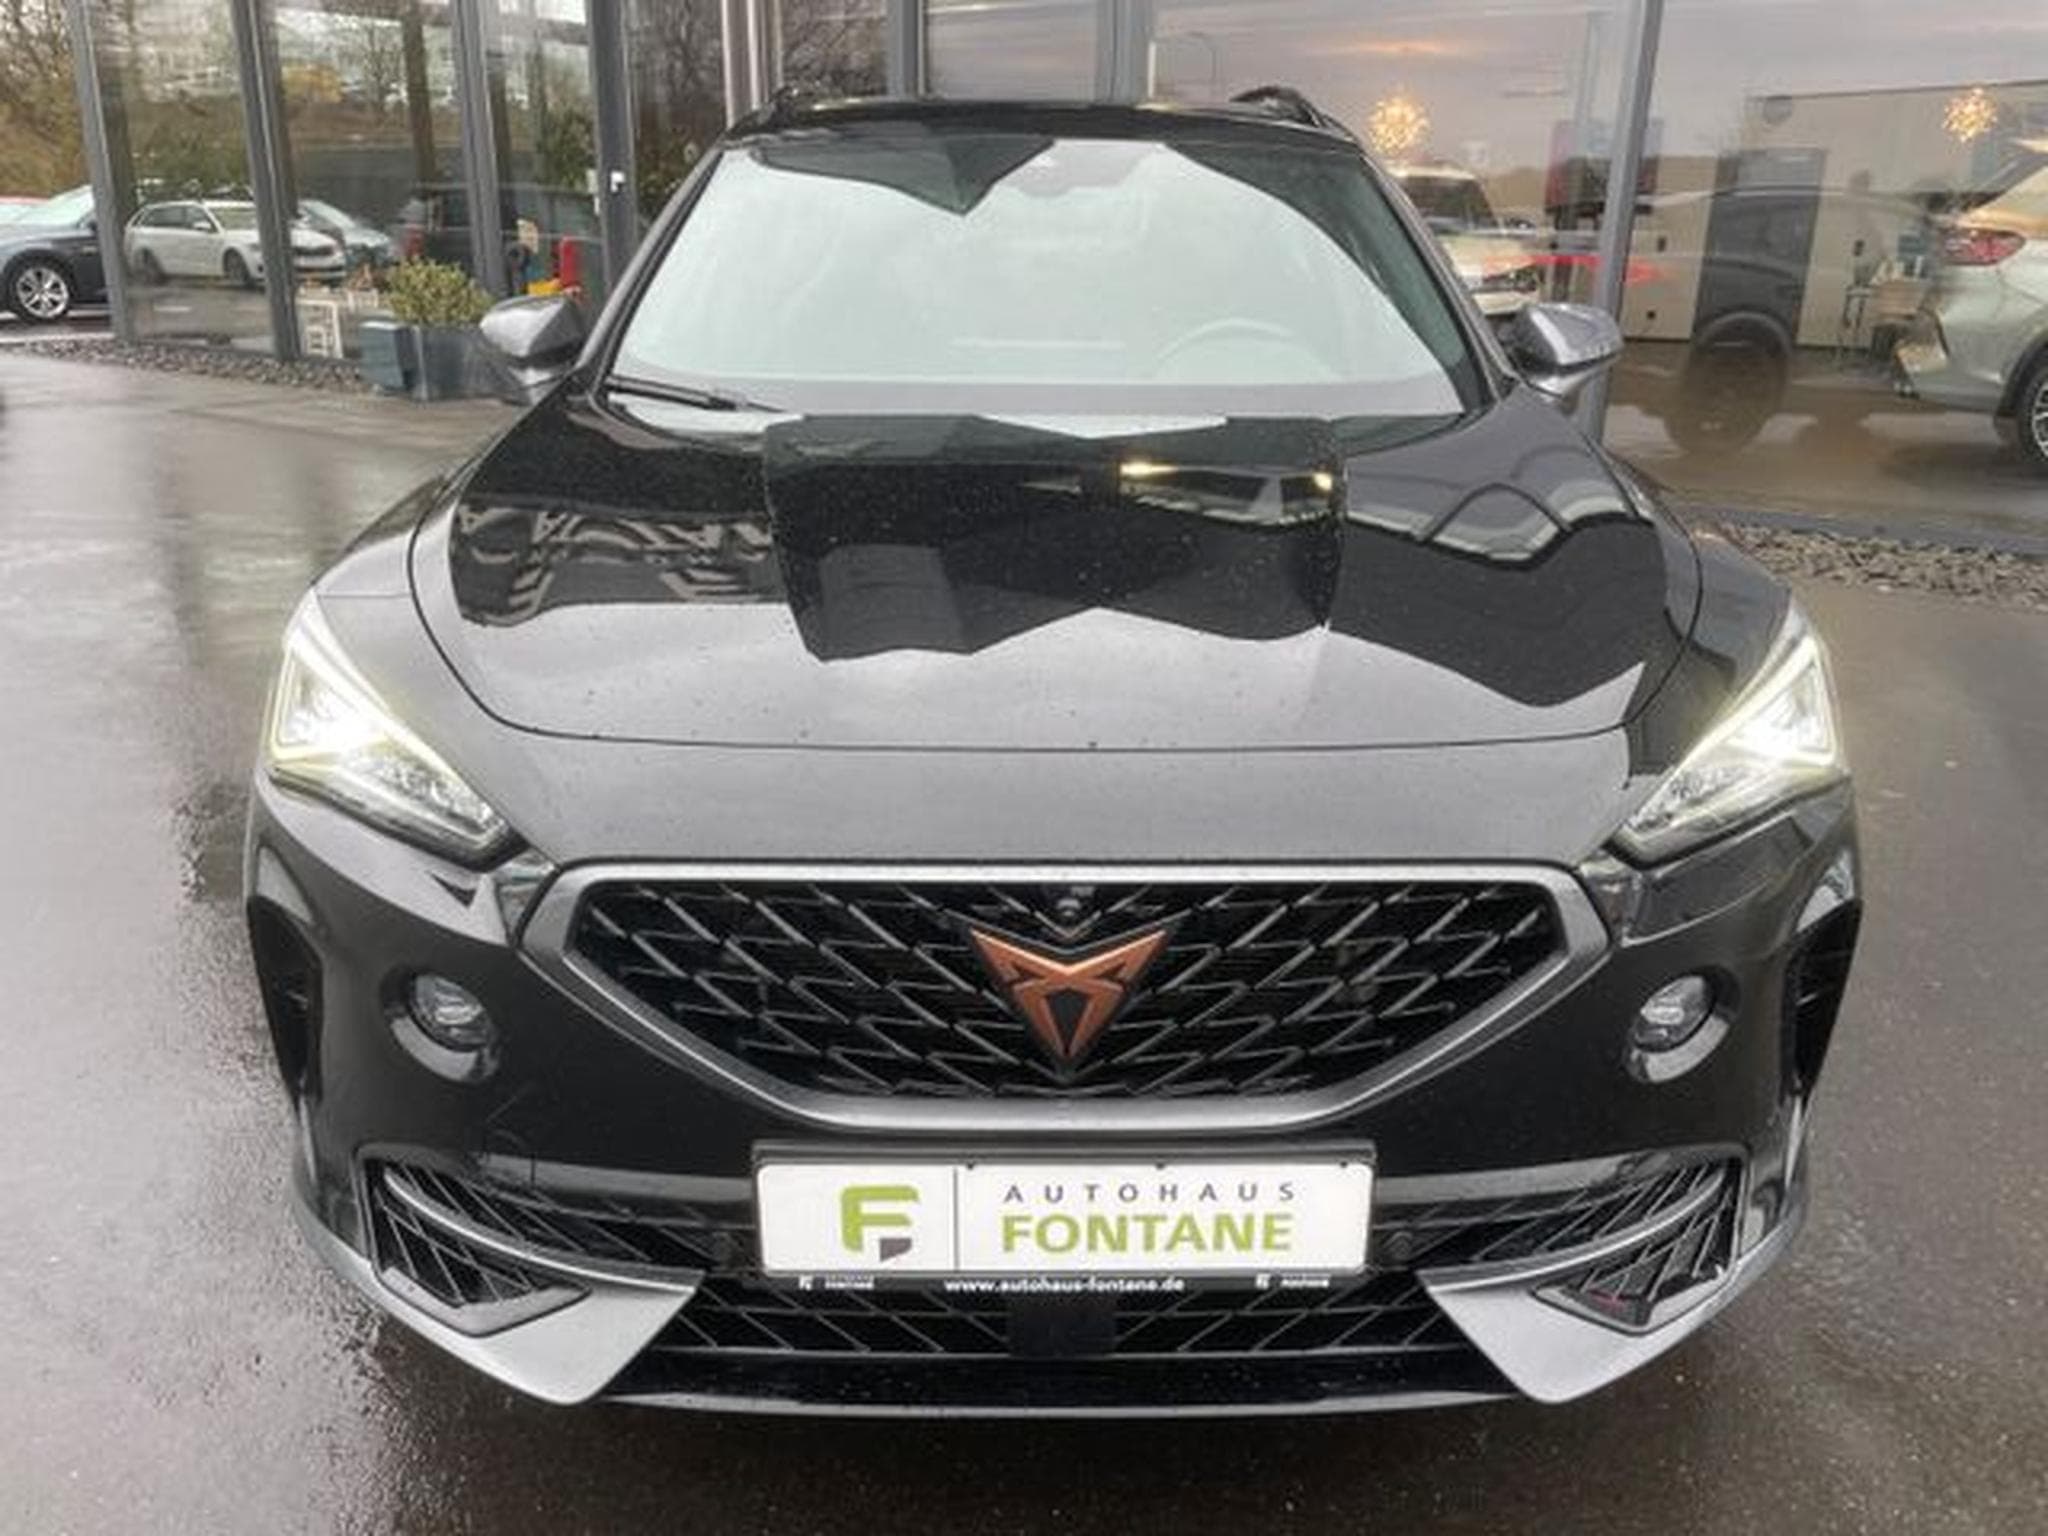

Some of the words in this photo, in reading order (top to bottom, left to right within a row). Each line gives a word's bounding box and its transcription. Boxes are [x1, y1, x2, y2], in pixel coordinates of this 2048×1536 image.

[1003, 1183, 1295, 1203] AUTOHAUS
[1002, 1212, 1294, 1254] FONTANE
[944, 1276, 1185, 1292] www.autohaus-fontane.de
